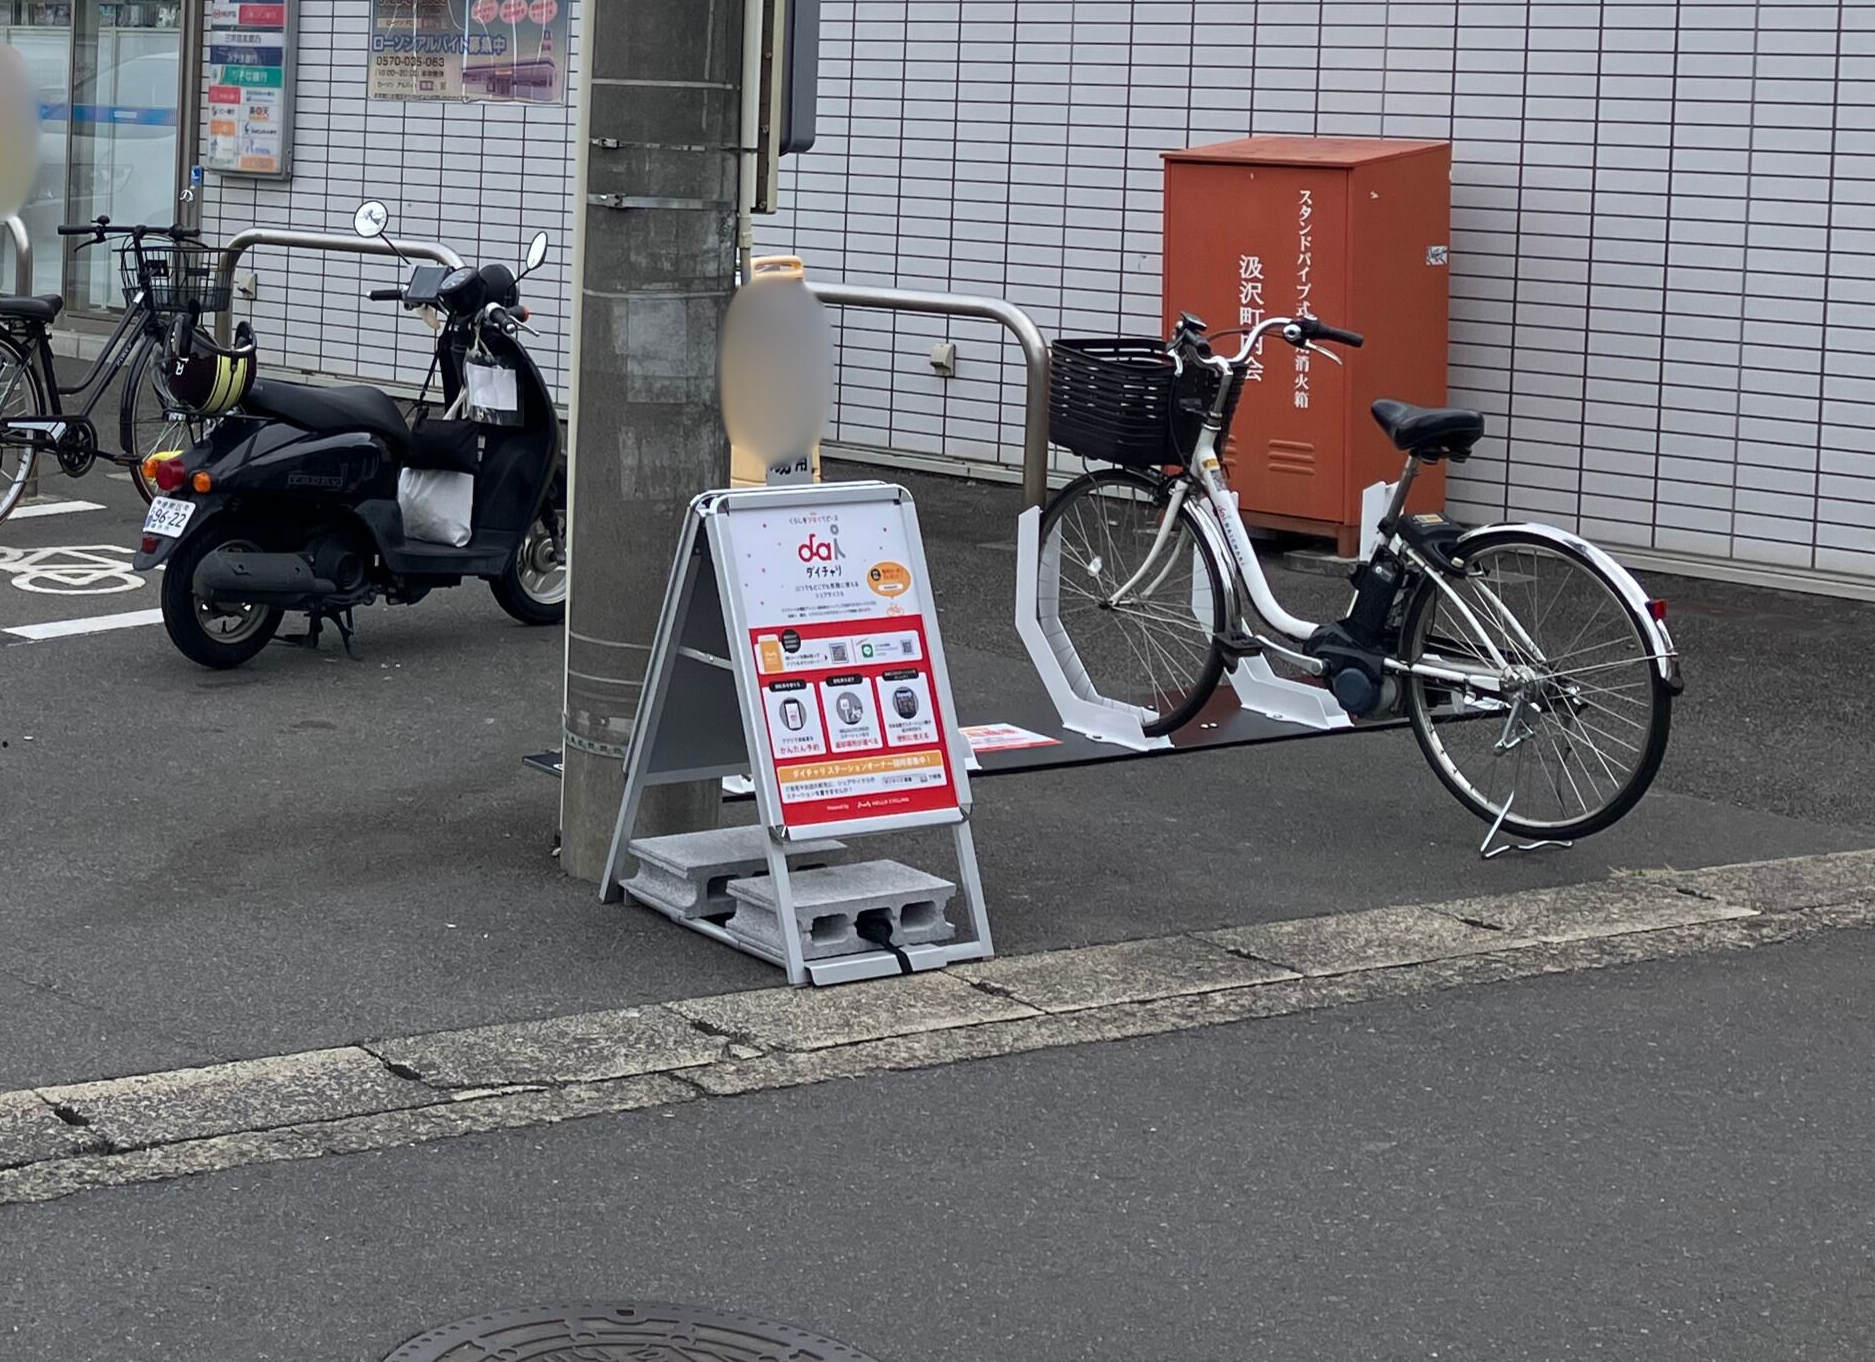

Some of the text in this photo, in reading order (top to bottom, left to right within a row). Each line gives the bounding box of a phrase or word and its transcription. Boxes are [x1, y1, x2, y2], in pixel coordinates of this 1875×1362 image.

[1294, 189, 1313, 410] スタンドパイプ式消火箱
[798, 524, 846, 563] dai
[806, 565, 842, 579] ダイチャリ
[780, 742, 820, 755] かんたん予約
